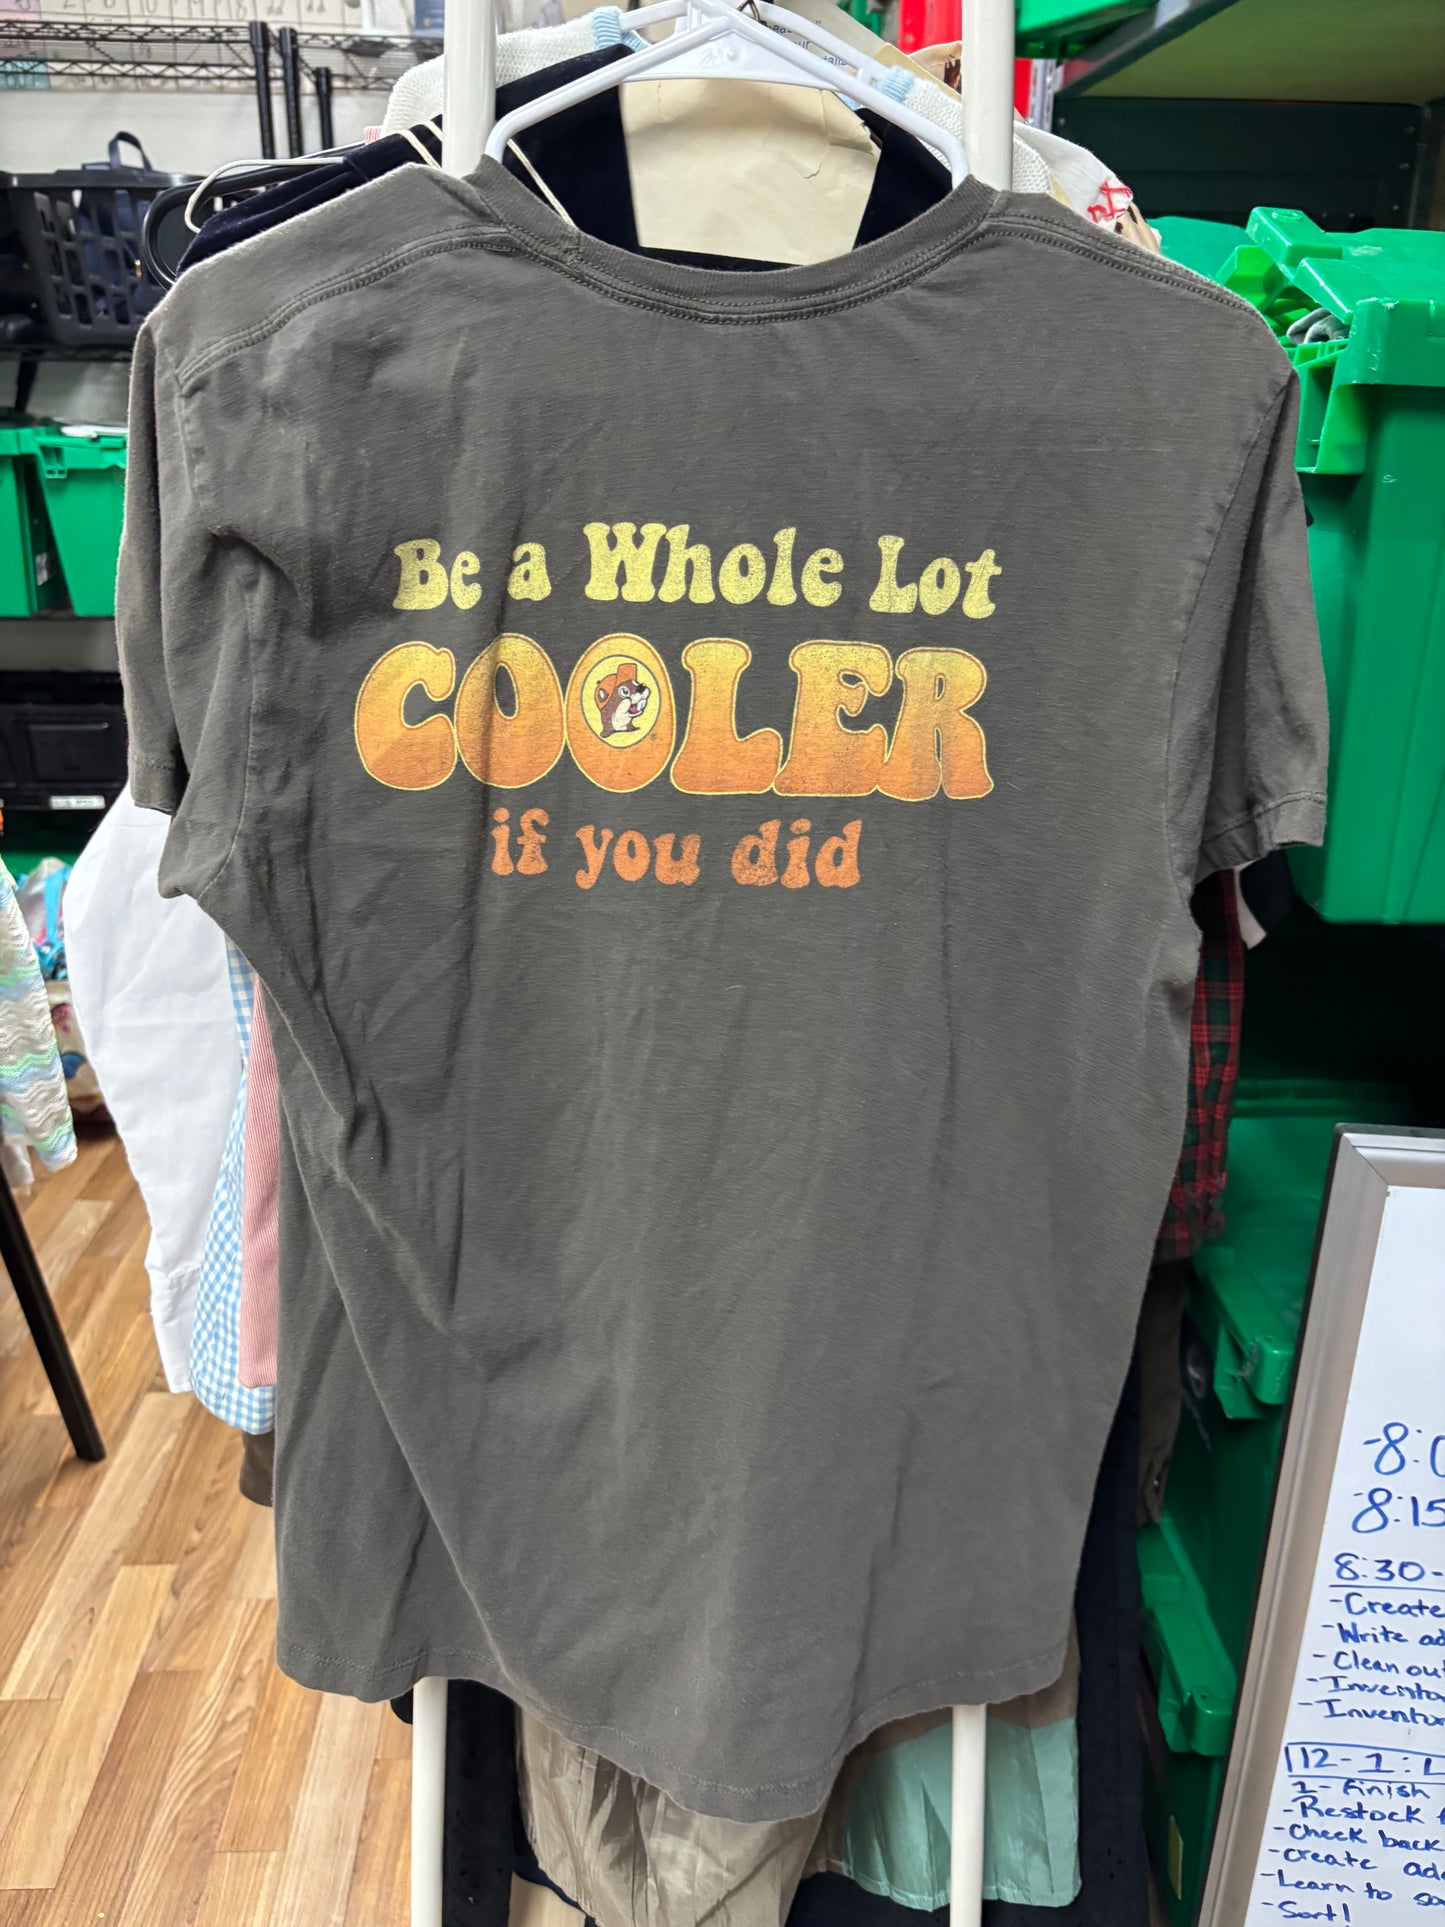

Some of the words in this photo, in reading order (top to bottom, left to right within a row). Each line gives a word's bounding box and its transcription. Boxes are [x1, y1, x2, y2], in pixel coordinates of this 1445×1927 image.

[393, 538, 481, 611] Be
[507, 542, 552, 602] a
[583, 521, 843, 606] Whole
[869, 534, 1002, 618] Lot
[353, 632, 994, 802] COOLER
[491, 807, 550, 876] if
[575, 824, 702, 890] you
[731, 818, 863, 889] did
[1364, 1882, 1393, 1901] to
